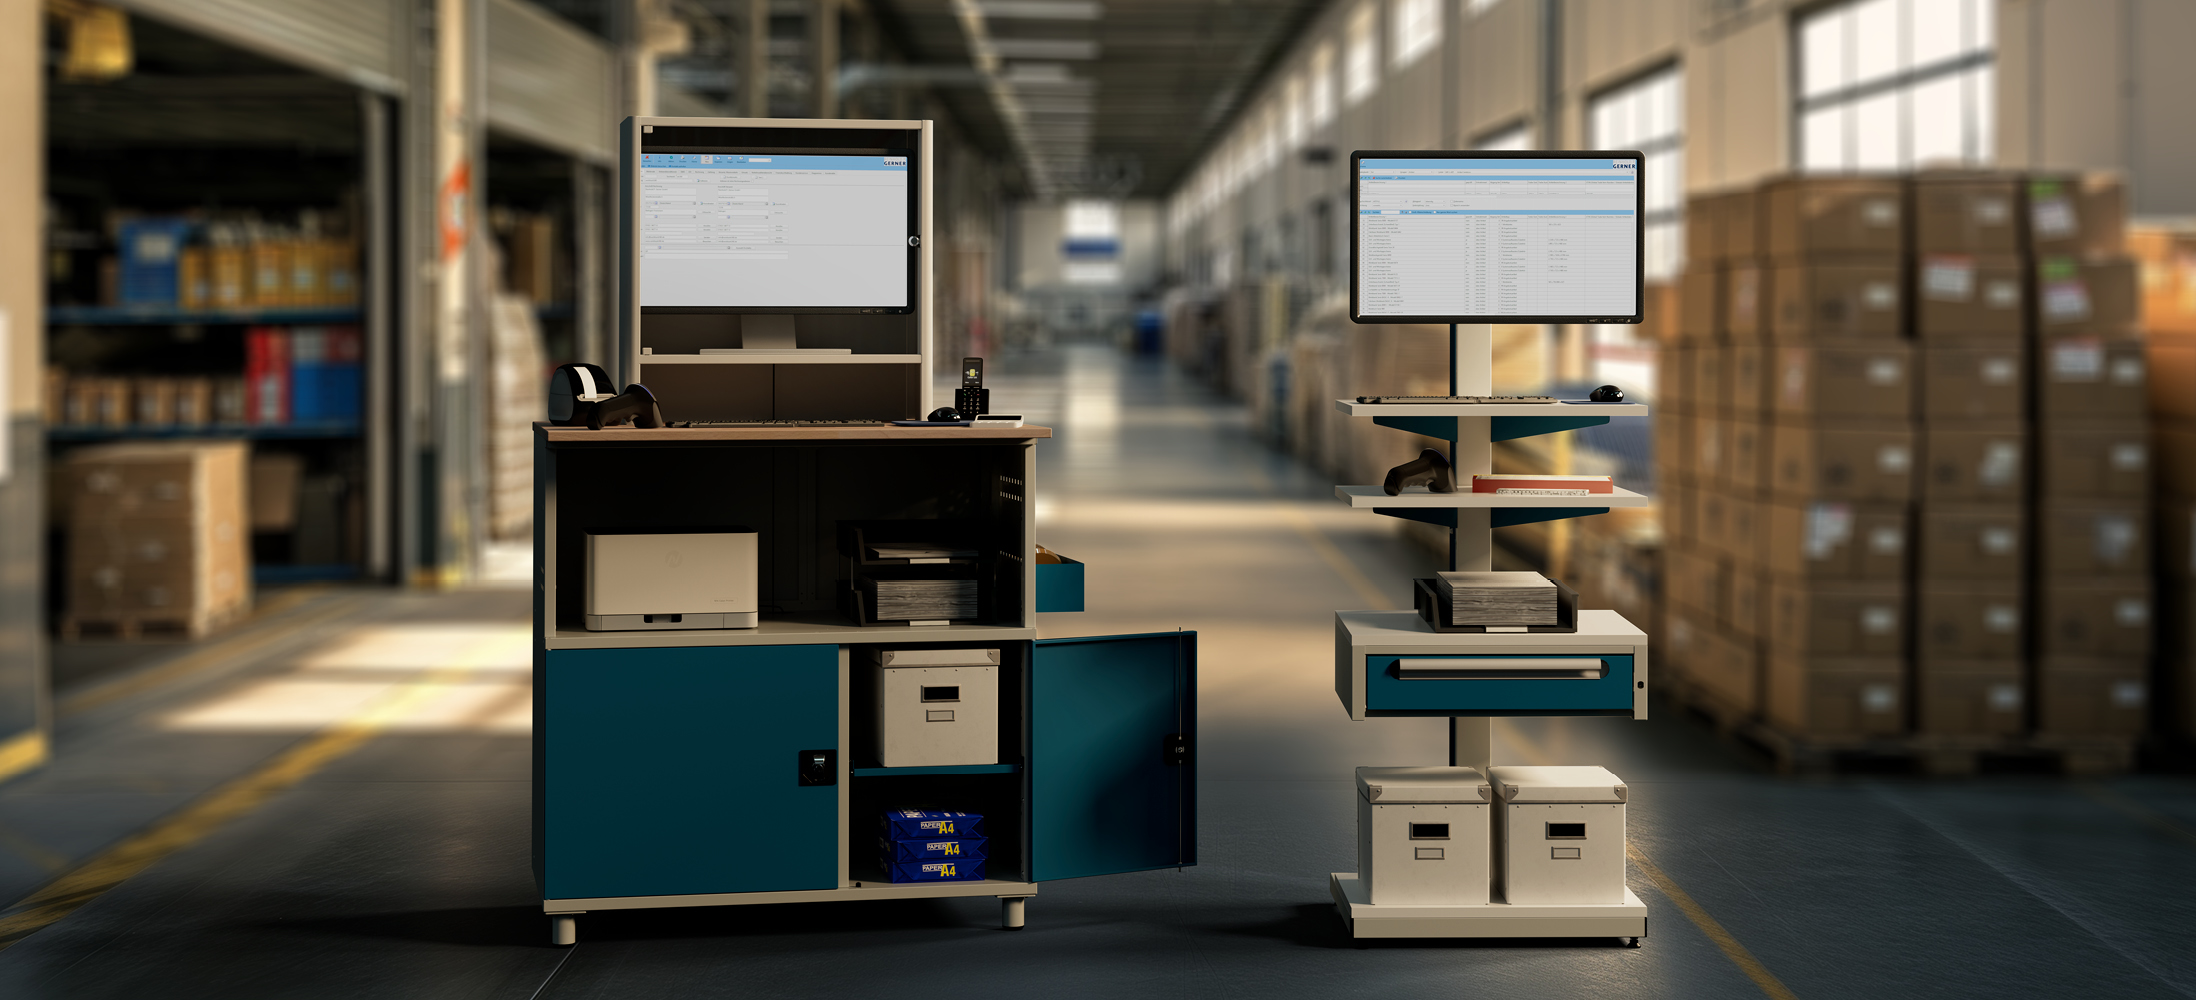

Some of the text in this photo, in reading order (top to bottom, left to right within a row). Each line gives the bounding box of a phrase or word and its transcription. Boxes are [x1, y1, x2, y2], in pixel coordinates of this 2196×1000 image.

[939, 821, 954, 834] A4
[945, 842, 960, 855] A4
[940, 864, 956, 877] A4
